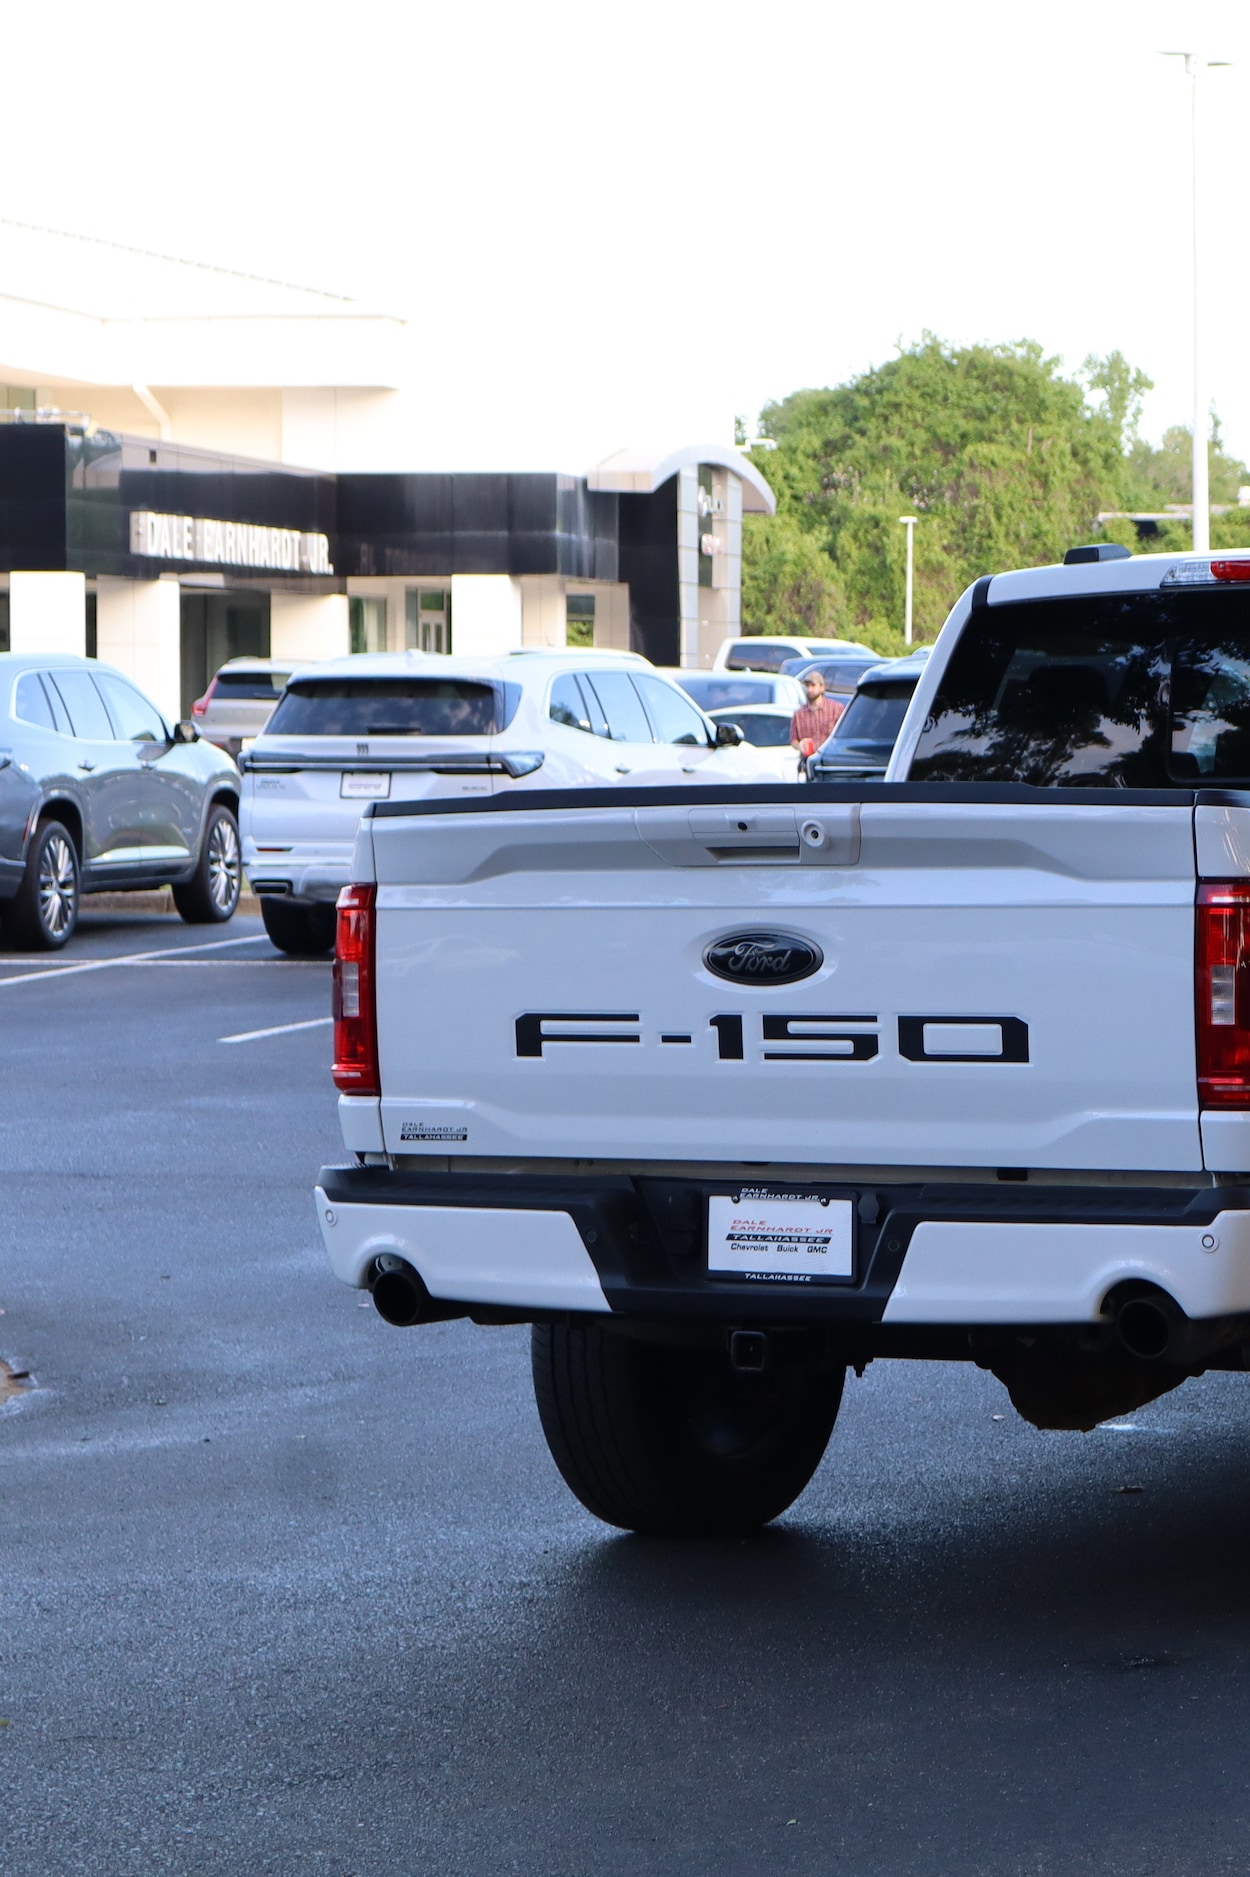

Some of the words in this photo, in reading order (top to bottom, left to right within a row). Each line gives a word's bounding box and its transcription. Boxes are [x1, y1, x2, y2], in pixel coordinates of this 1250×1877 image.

[147, 512, 194, 560] DALE
[198, 518, 301, 571] EARNHARDT
[728, 941, 792, 972] Ford
[514, 1012, 1030, 1063] F-150
[730, 1225, 812, 1233] EARNHARDT
[733, 1235, 825, 1243] TALLAHASSEE
[730, 1243, 768, 1252] Chevrolet
[776, 1244, 799, 1254] Buick
[806, 1245, 828, 1254] GMC
[744, 1273, 813, 1282] TALLAHASSEE
